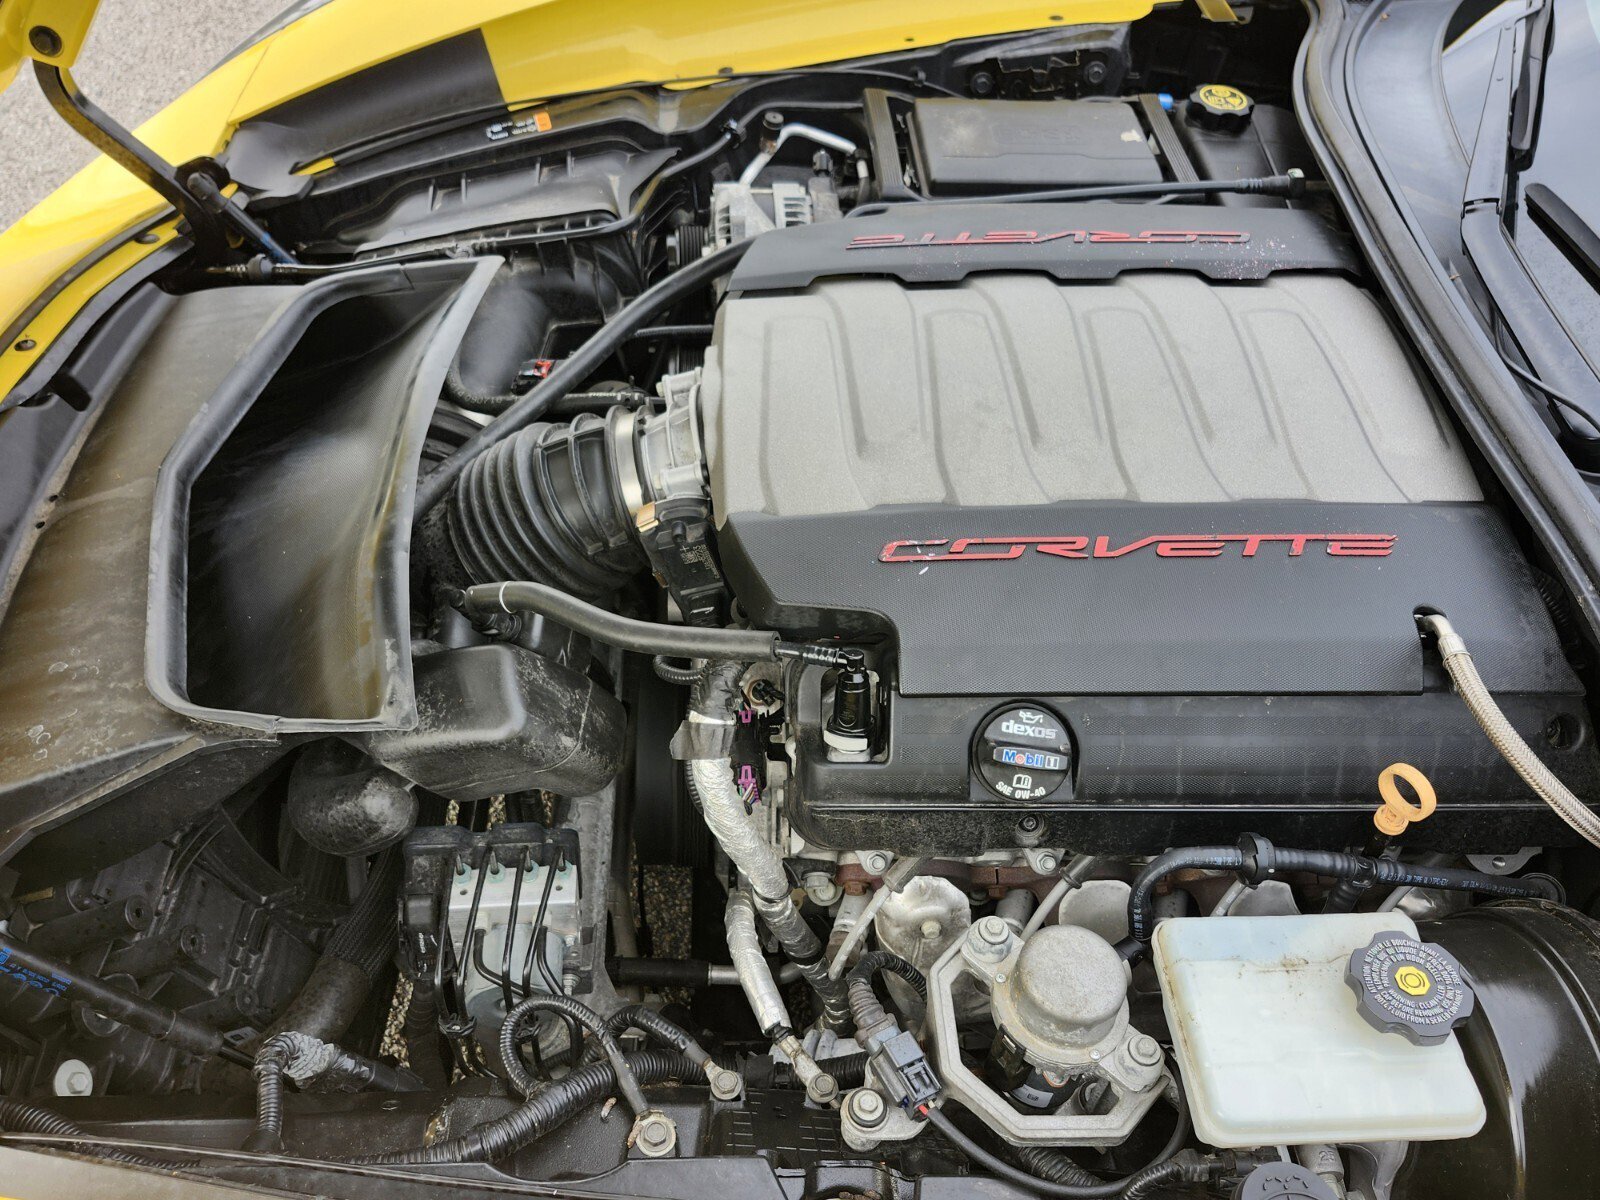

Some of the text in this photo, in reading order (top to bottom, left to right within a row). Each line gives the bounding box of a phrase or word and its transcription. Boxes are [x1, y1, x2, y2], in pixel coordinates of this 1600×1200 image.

[878, 532, 1398, 562] CORVETTE
[1001, 720, 1057, 739] dexos
[1002, 748, 1044, 768] Mobil
[995, 781, 1046, 799] SAE 0W-40
[1383, 940, 1392, 948] LE
[1391, 939, 1419, 949] BOUCHON
[1420, 945, 1439, 960] AVANT
[1439, 957, 1447, 967] LA
[1405, 954, 1425, 964] BIDON
[1419, 950, 1427, 959] DE
[1380, 990, 1393, 1003] CAP
[1390, 998, 1414, 1015] BEFORE
[1388, 1006, 1406, 1020] FLUID
[1406, 1014, 1425, 1024] FROM
[1425, 1017, 1430, 1025] A
[1430, 1010, 1451, 1025] SEALED
